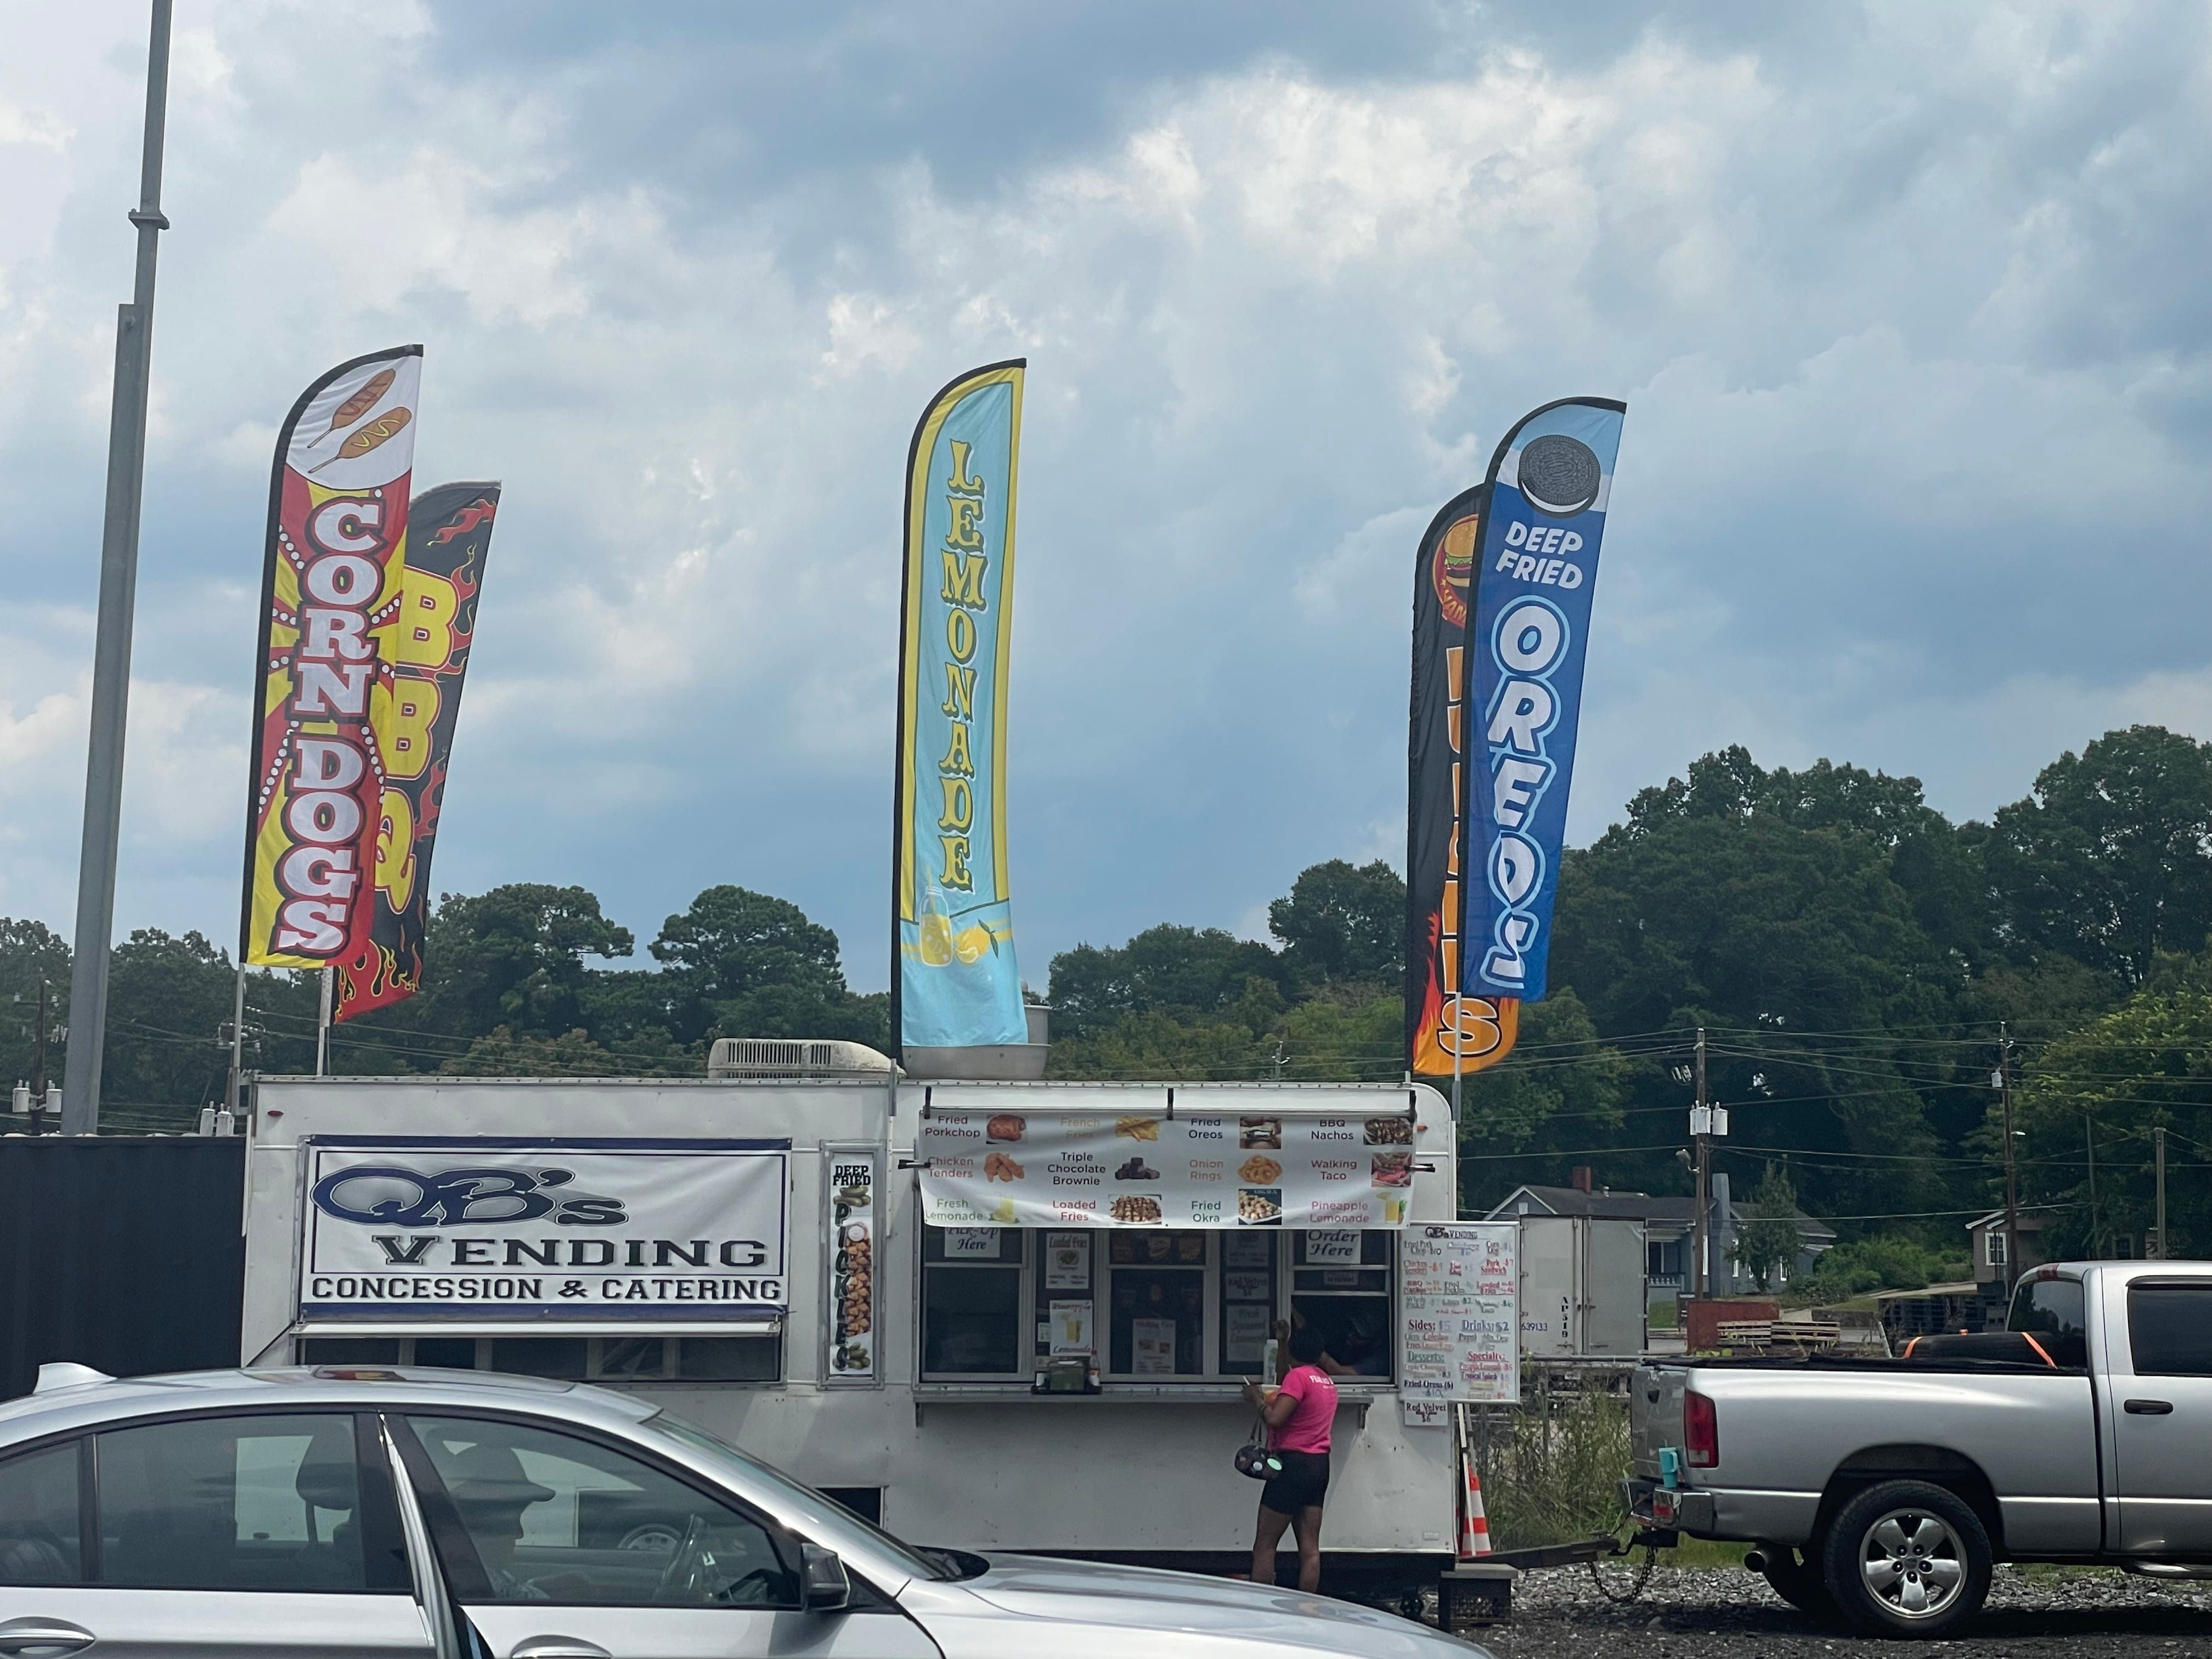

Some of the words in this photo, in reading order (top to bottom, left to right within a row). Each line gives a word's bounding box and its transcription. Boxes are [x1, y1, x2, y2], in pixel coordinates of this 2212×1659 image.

[1505, 521, 1583, 555] DEEP
[1496, 550, 1583, 589] FRIED
[293, 500, 380, 714] CORN
[939, 438, 988, 893] LEMONADE
[276, 738, 364, 952] DOGS
[938, 1115, 968, 1125] Fried
[1060, 1117, 1101, 1127] French
[1190, 1118, 1221, 1127] Fried
[1319, 1119, 1346, 1128] BBQ
[925, 1127, 980, 1139] Porkchop
[1188, 1130, 1223, 1139] Oreos
[1311, 1131, 1353, 1140] Nachos
[928, 1156, 974, 1166] Chicken
[1060, 1153, 1093, 1164] Triple
[1047, 1164, 1106, 1173] Chocolate
[1189, 1159, 1224, 1169] Onion
[1311, 1160, 1357, 1170] Walking
[834, 1165, 870, 1177] DEEP
[928, 1169, 974, 1178] Tenders
[1320, 1171, 1347, 1181] Taco
[833, 1175, 871, 1186] FRIED
[1053, 1176, 1101, 1186] Brownie
[1190, 1171, 1222, 1182] Rings
[309, 1166, 629, 1227] QB's
[937, 1199, 968, 1208] Fresh
[1053, 1200, 1096, 1210] Loaded
[1191, 1200, 1221, 1210] Fried
[1311, 1201, 1369, 1212] Pineapple
[926, 1211, 983, 1221] Lemonade
[1060, 1212, 1089, 1221] Fries
[1193, 1213, 1220, 1223] Okra
[1310, 1213, 1370, 1223] Lemonade
[1308, 1229, 1360, 1242] Order
[1449, 1230, 1478, 1239] VENDING
[957, 1238, 987, 1250] Here
[372, 1234, 767, 1267] VENDING
[1309, 1243, 1353, 1256] Here
[312, 1277, 543, 1300] CONCESSION
[558, 1279, 589, 1298] &
[602, 1279, 782, 1300] CATERING
[1408, 1319, 1436, 1330] Sides:
[1521, 1322, 1548, 1331] 639133
[1404, 1379, 1422, 1387] Fried
[1406, 1402, 1420, 1412] Red
[1423, 1402, 1446, 1412] Velvet
